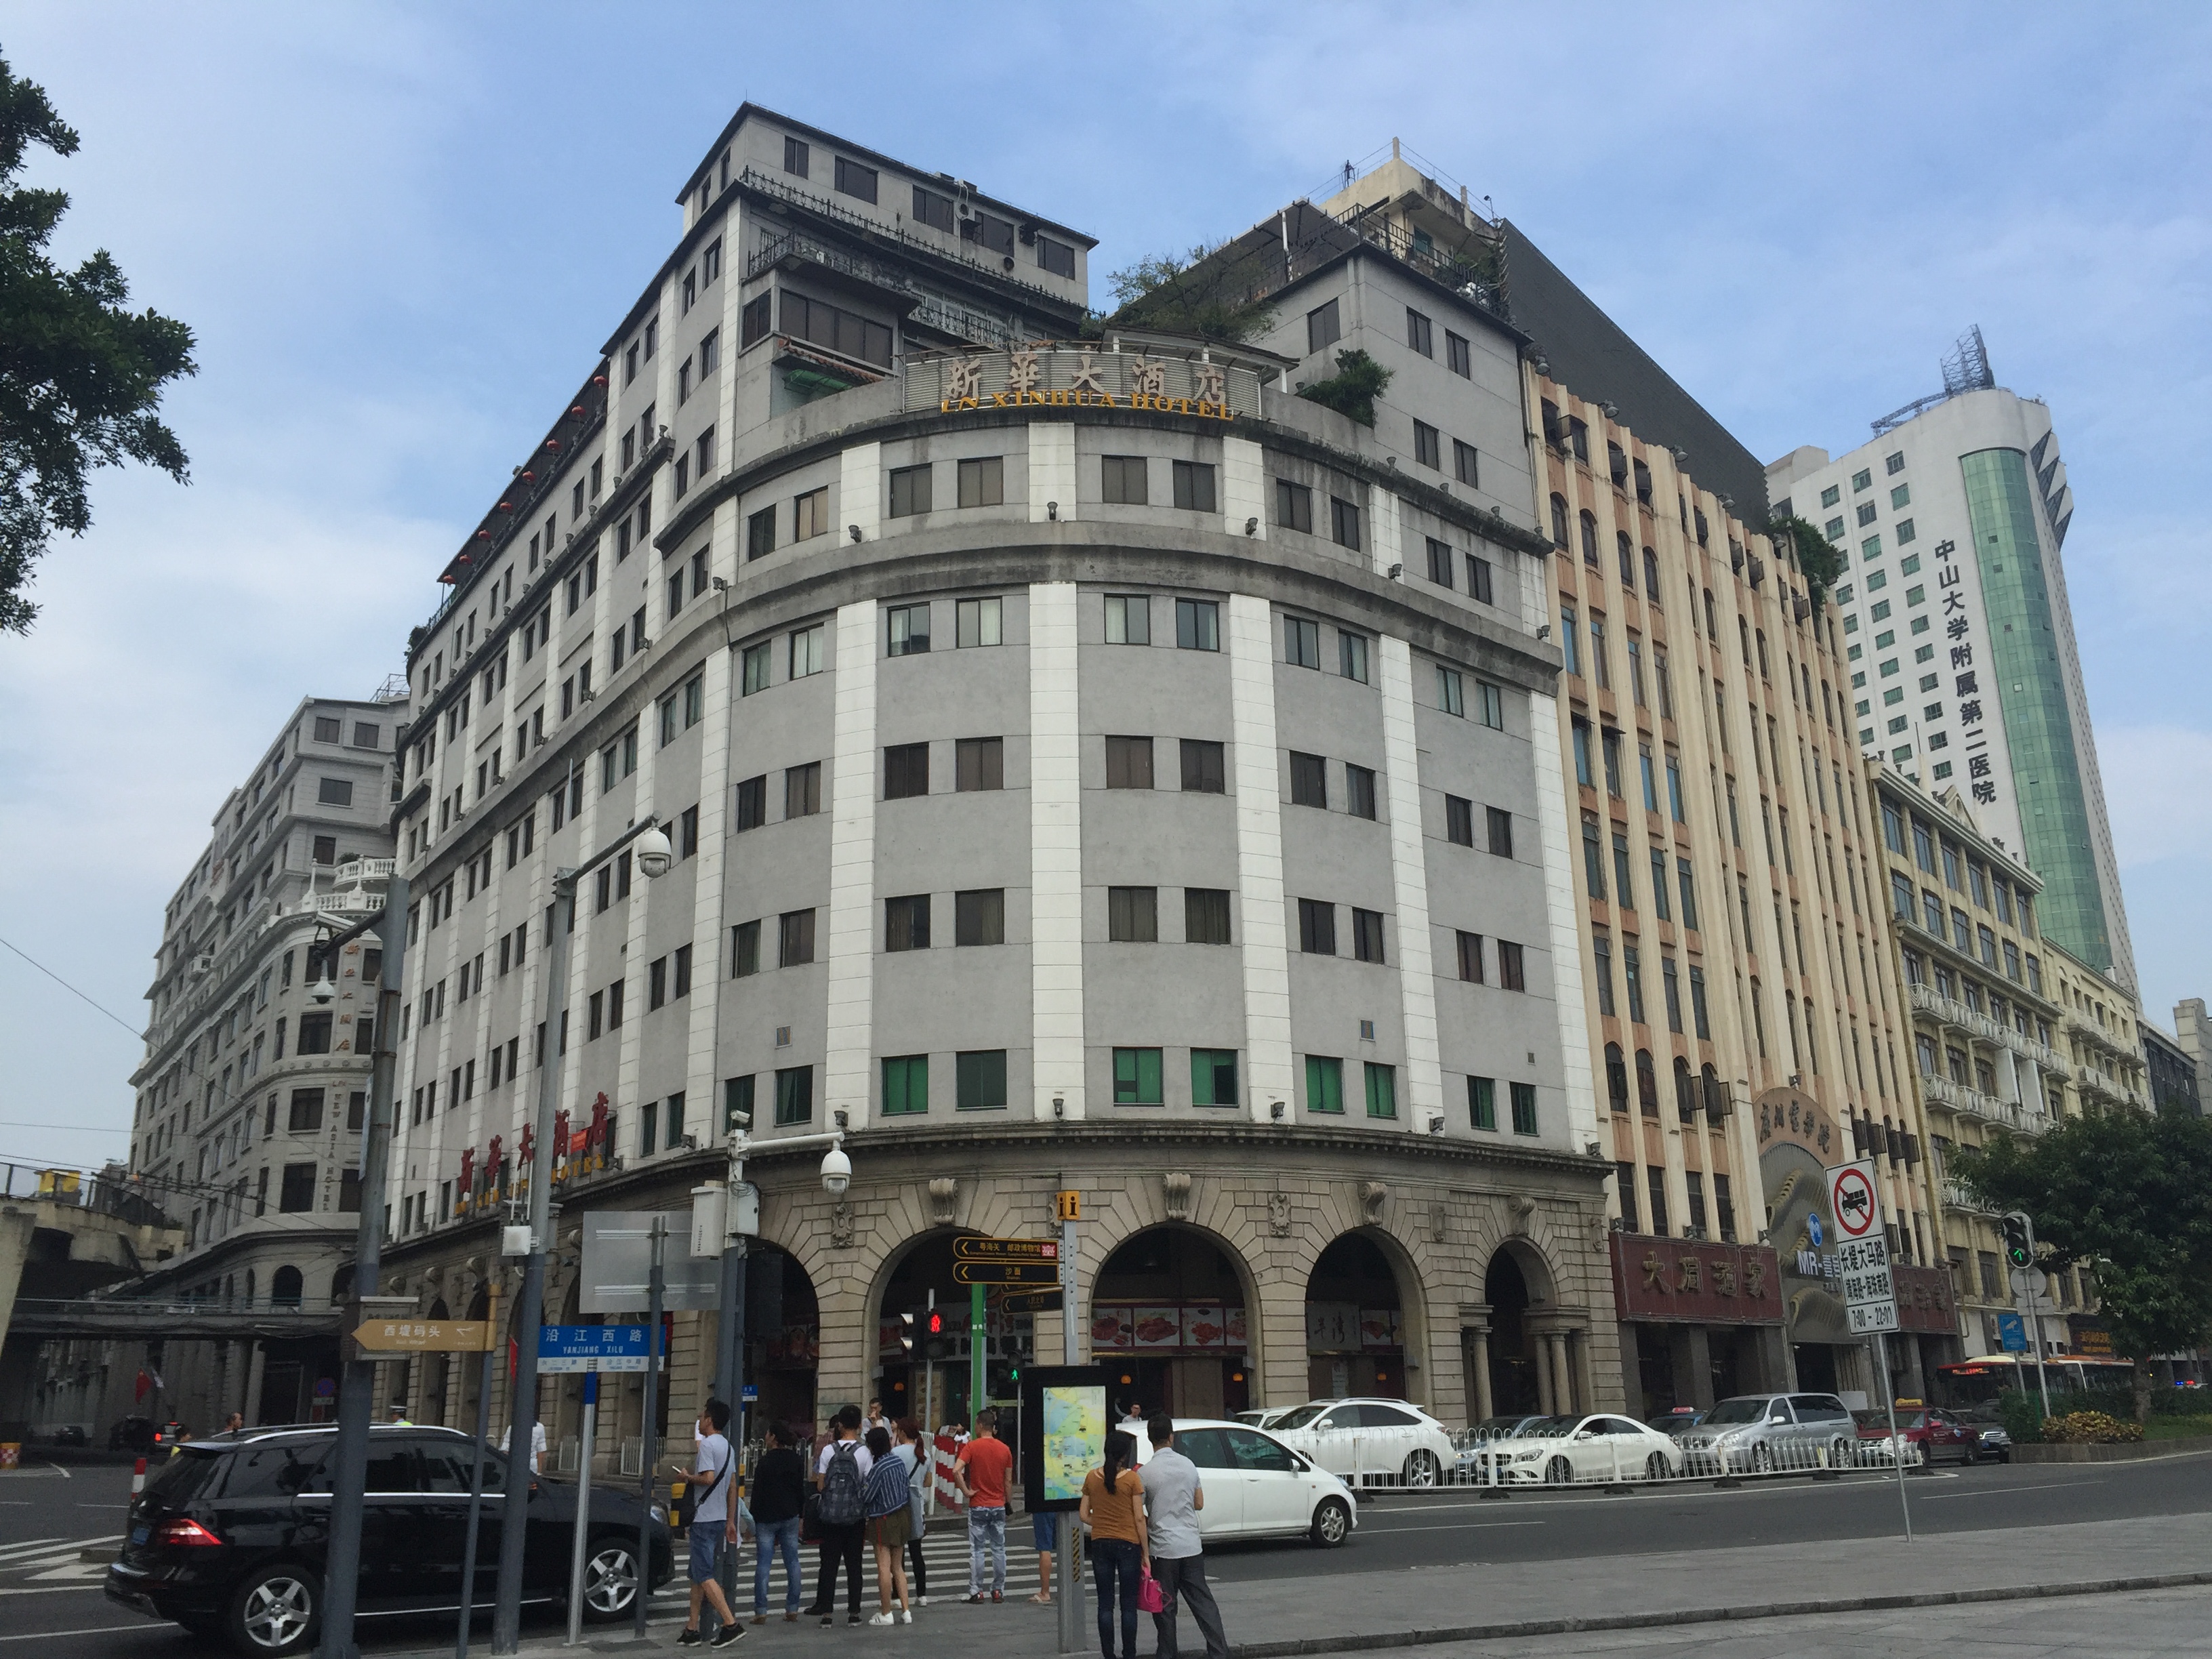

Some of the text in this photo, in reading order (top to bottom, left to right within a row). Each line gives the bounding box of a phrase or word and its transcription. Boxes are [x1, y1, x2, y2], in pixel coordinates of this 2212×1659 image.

[945, 352, 1225, 405] 新華大酒店
[991, 390, 1117, 408] XINHUA
[1130, 393, 1233, 421] HOTEL
[1934, 539, 1996, 806] 中山大学附属第二医院
[329, 1125, 337, 1159] ASIA
[323, 1167, 333, 1211] HOTEL
[1841, 1240, 1886, 1273] 长堤大马路
[1852, 1309, 1866, 1328] 7:00
[546, 1328, 642, 1343] 沿江西路
[562, 1345, 623, 1354] YANJIANG XILU
